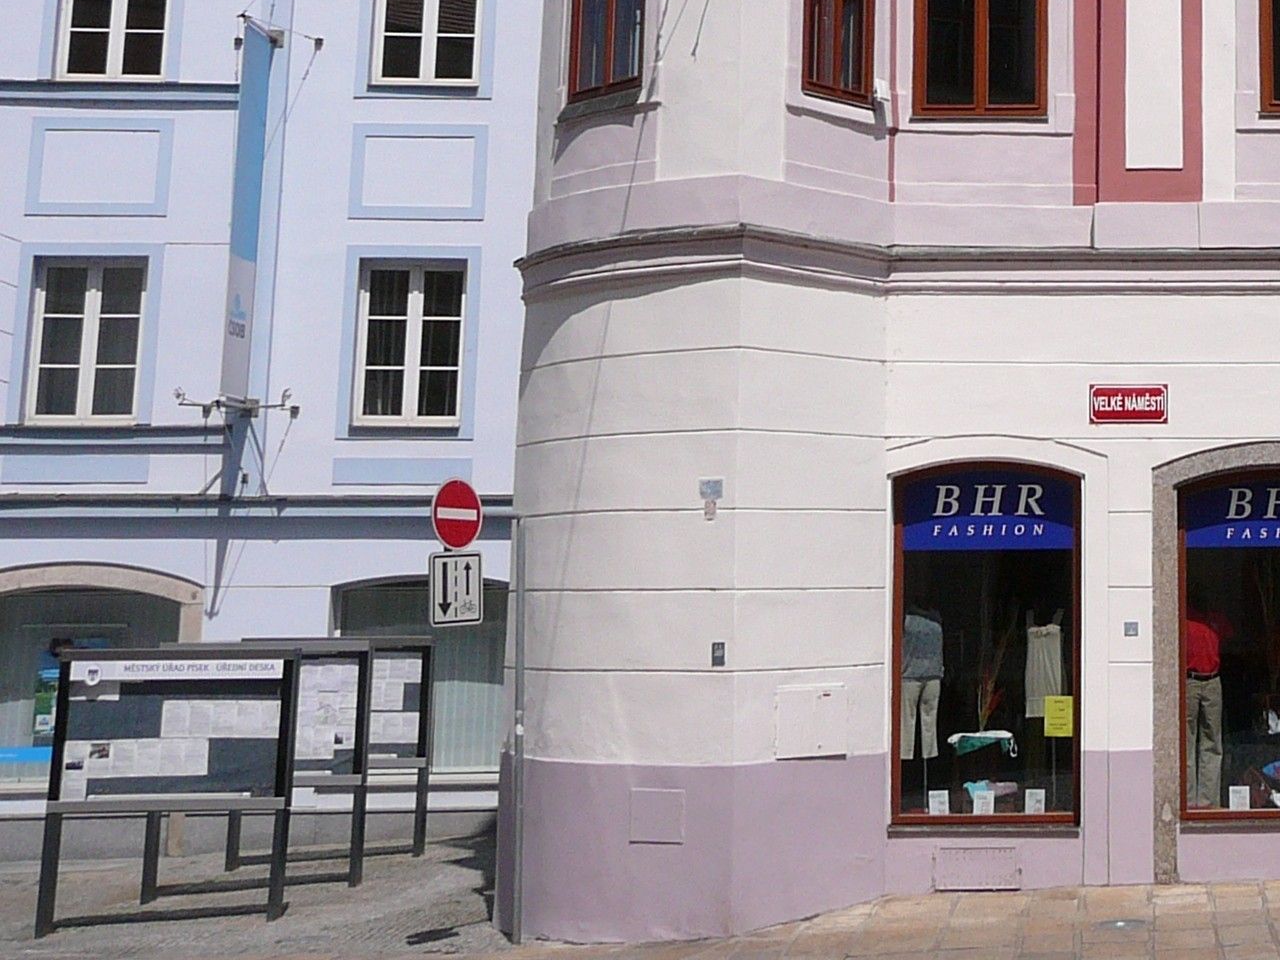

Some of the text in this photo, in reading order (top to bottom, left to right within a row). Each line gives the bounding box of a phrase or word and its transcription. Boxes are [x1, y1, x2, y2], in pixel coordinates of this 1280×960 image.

[1093, 393, 1164, 411] VELKÉ NÁMĚSTÍ
[932, 484, 1045, 517] BHR
[932, 524, 1044, 536] FASHION
